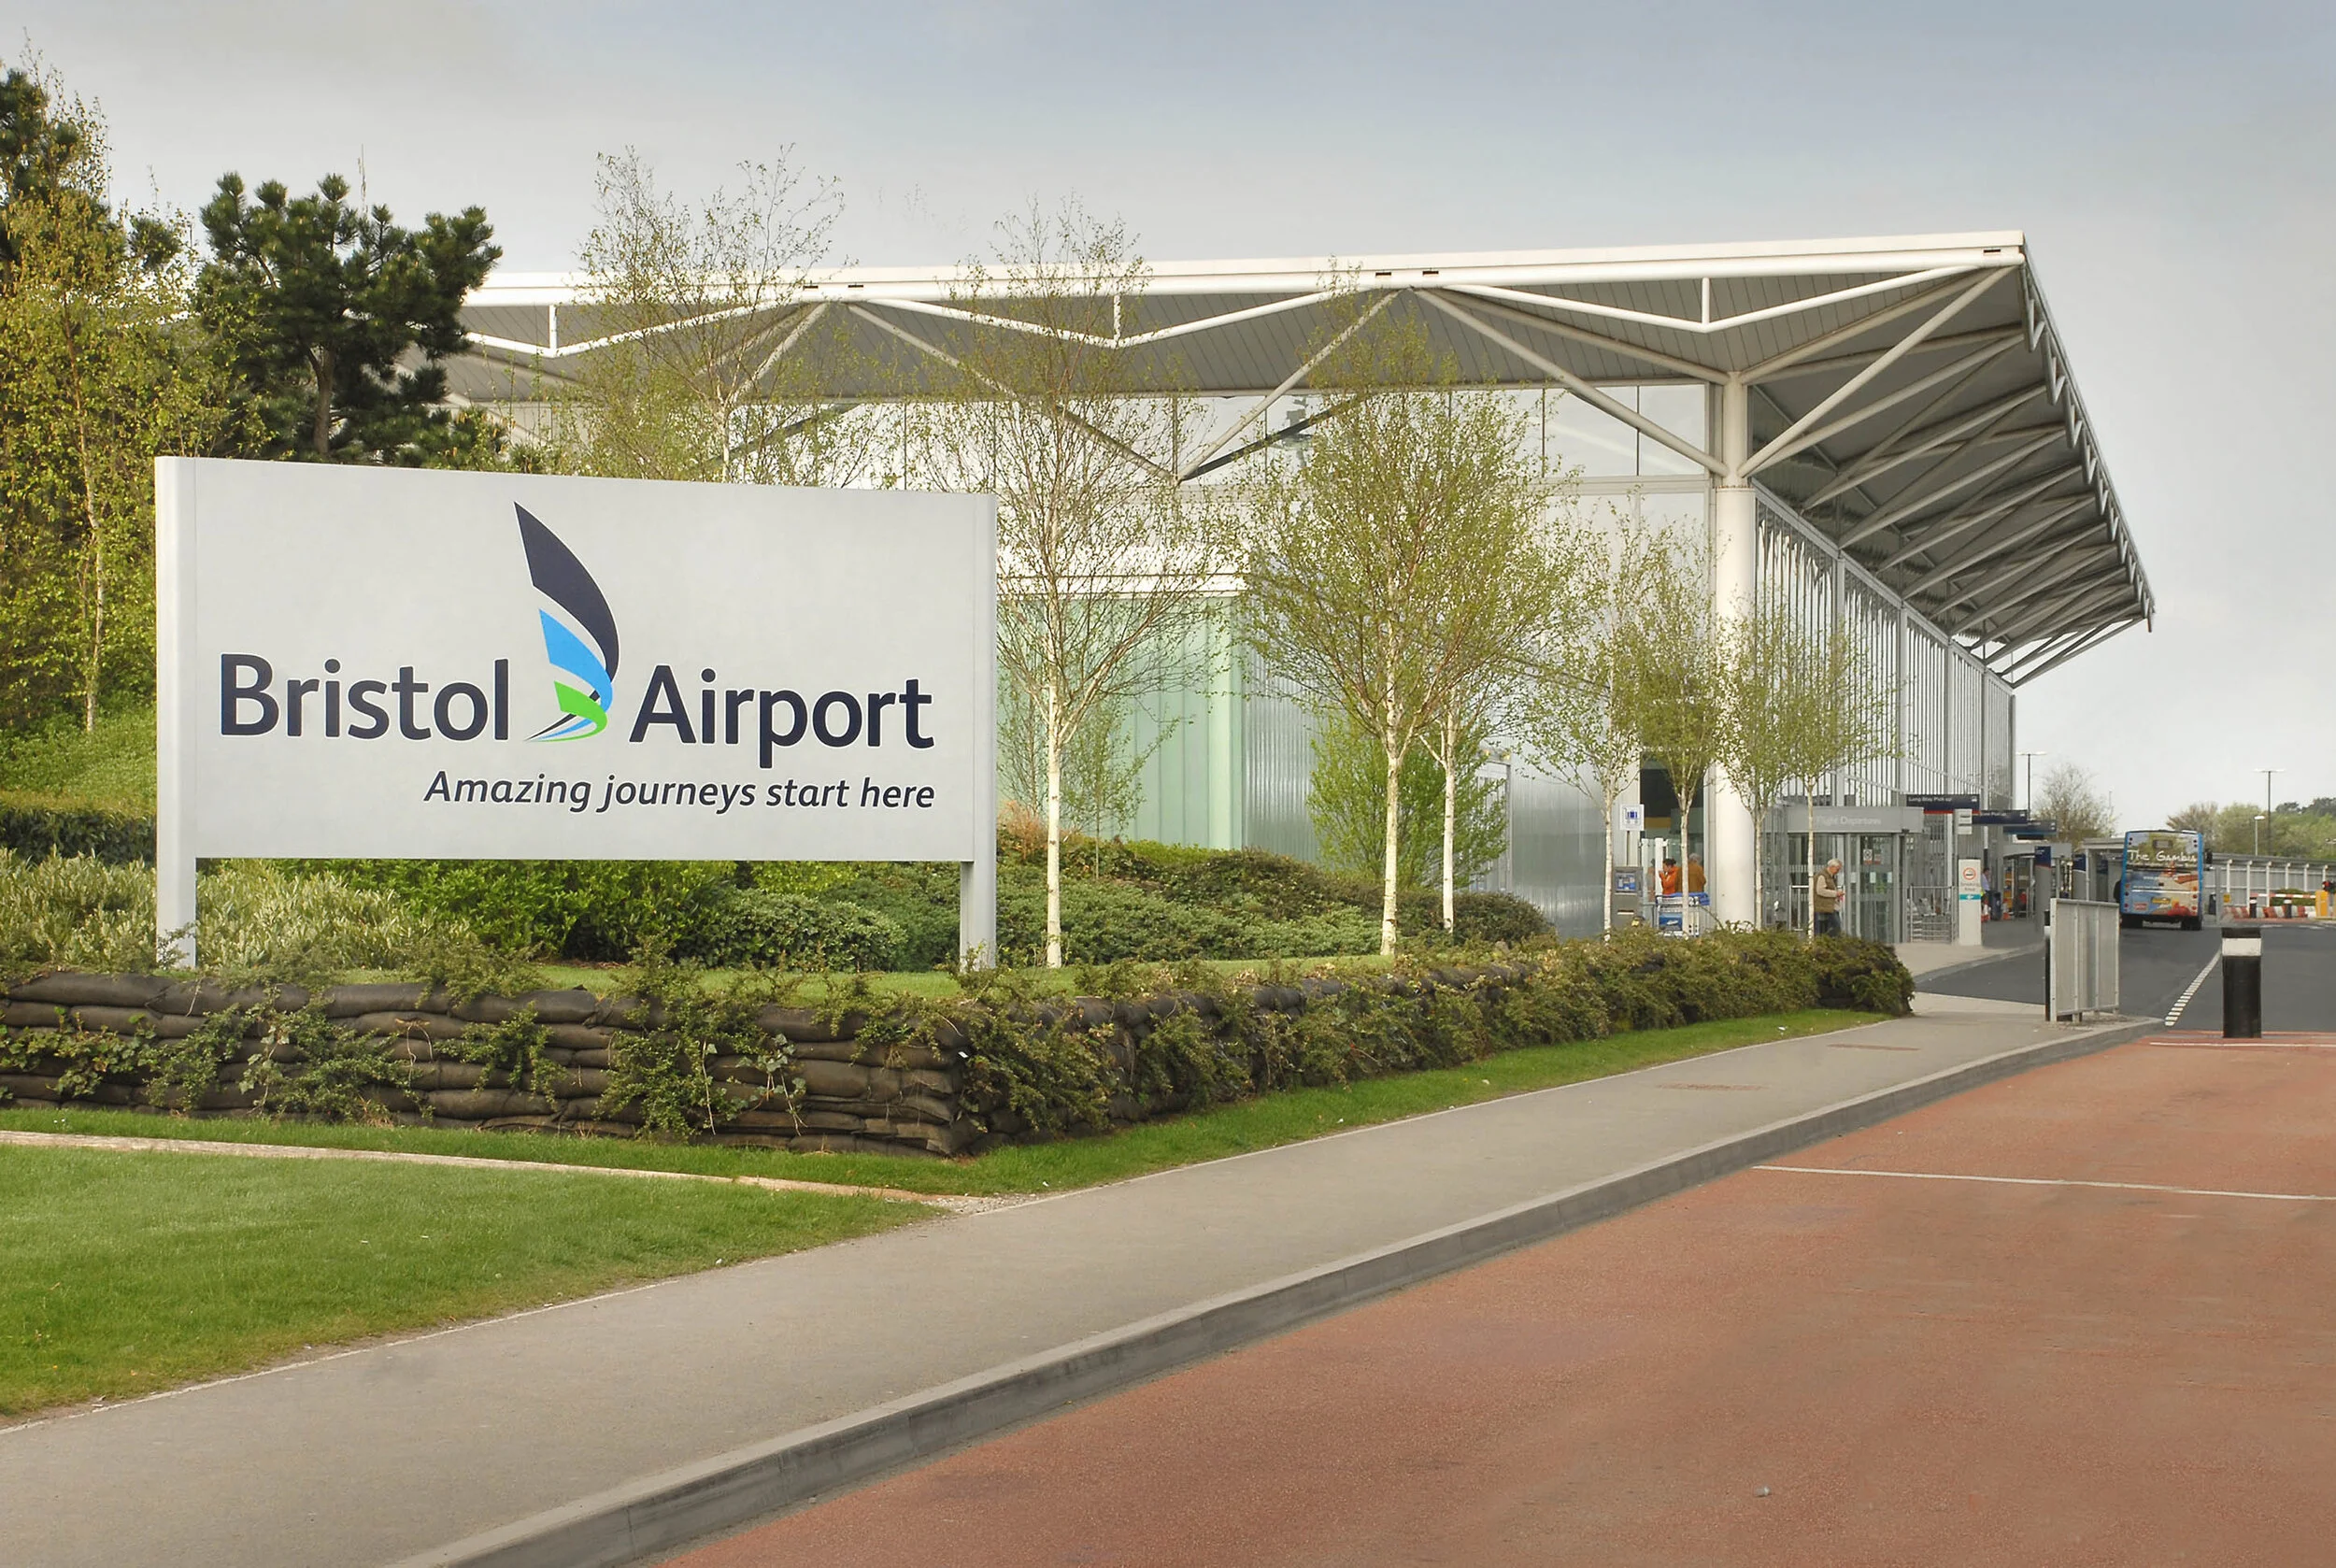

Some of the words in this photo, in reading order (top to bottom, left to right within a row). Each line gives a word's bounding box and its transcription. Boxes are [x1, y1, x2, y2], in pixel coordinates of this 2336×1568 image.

[221, 653, 509, 741] Bristol
[629, 663, 934, 769] Airport
[423, 770, 591, 813] Amazing
[595, 774, 756, 815] journeys
[765, 779, 850, 807] start
[860, 777, 934, 808] here
[2127, 849, 2150, 862] The
[2156, 850, 2198, 862] Gambia
